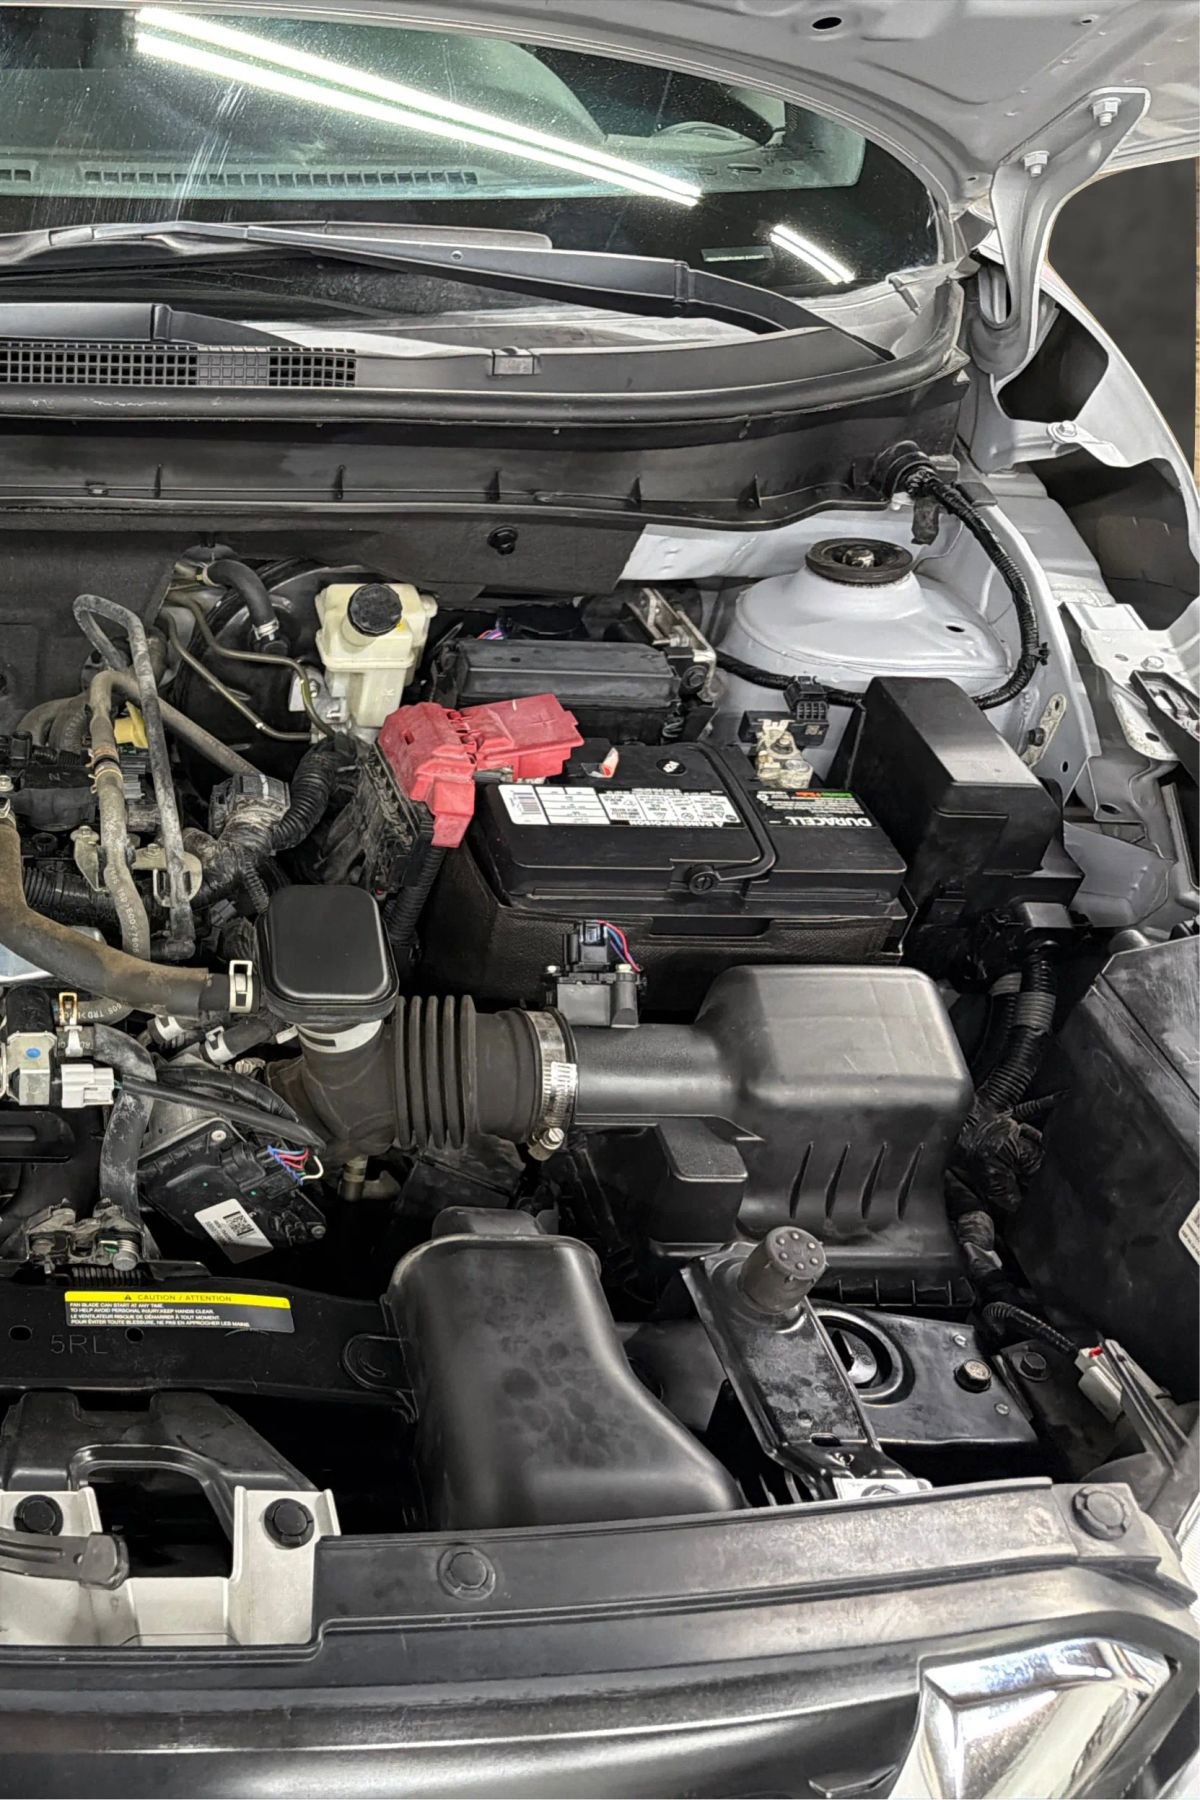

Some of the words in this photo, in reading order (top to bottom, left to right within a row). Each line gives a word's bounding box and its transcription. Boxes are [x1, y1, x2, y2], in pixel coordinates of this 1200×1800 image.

[785, 816, 873, 827] DURACELL
[185, 1295, 232, 1303] ATTENTION
[50, 1334, 109, 1355] 5RL
